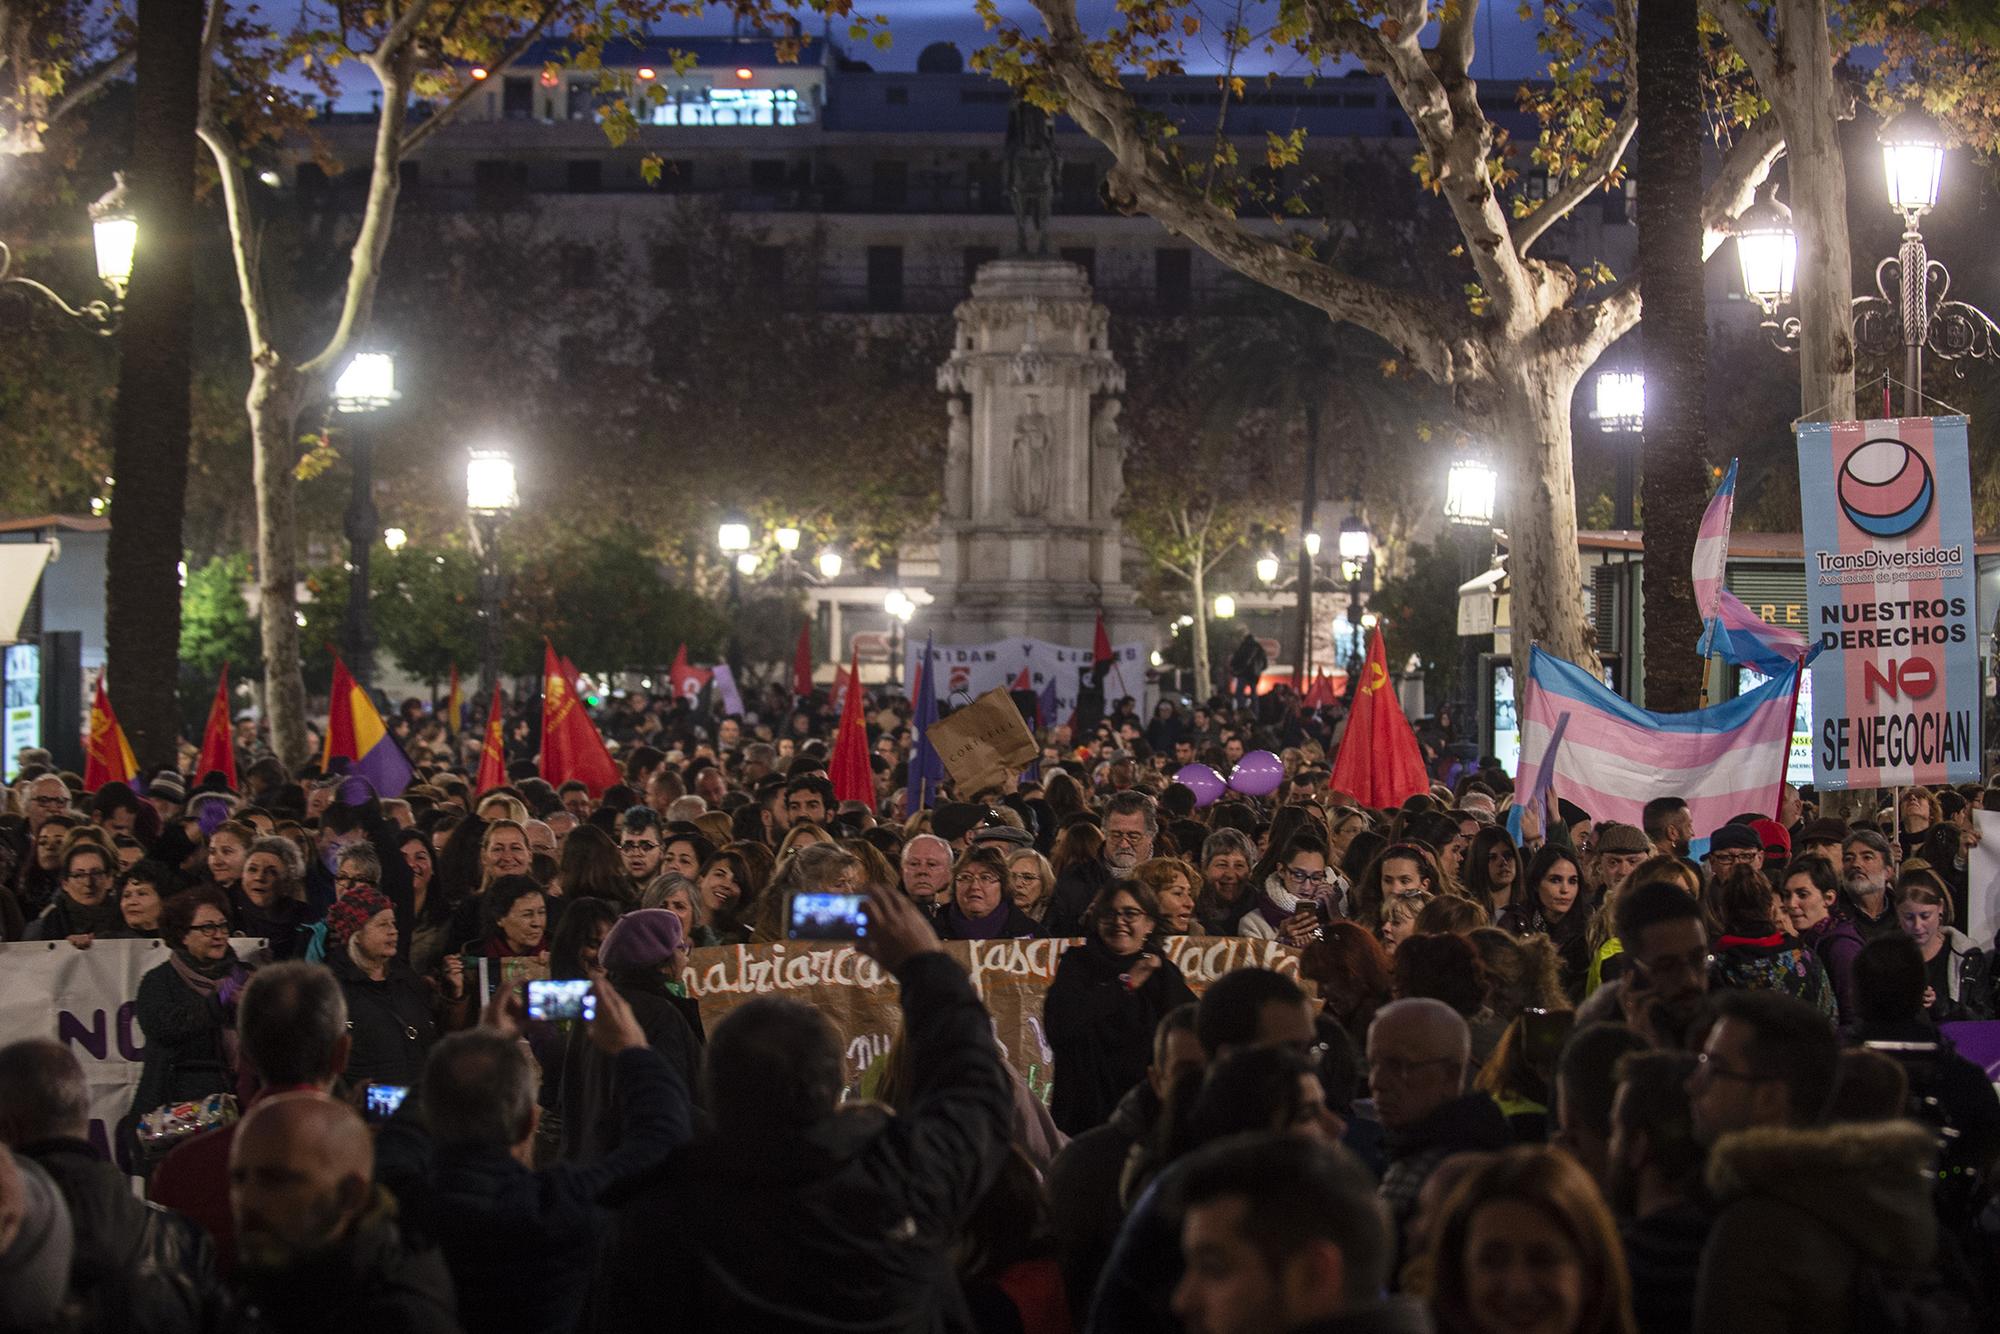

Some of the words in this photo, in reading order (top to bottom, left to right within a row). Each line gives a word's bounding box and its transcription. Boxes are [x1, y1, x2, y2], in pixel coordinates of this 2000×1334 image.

[1817, 545, 1963, 571] TransDiversidad
[1875, 572, 1890, 583] de
[1891, 571, 1936, 584] personas
[1821, 598, 1967, 624] NUESTROS
[1821, 624, 1967, 650] DERECHOS
[1022, 643, 1033, 657] Y
[1057, 648, 1136, 662] LIBES
[1006, 671, 1044, 685] PR
[1863, 656, 1937, 700] NO
[1822, 717, 1851, 771] SE
[1858, 710, 1971, 768] NEGOCIAN
[681, 942, 900, 999] atriarca
